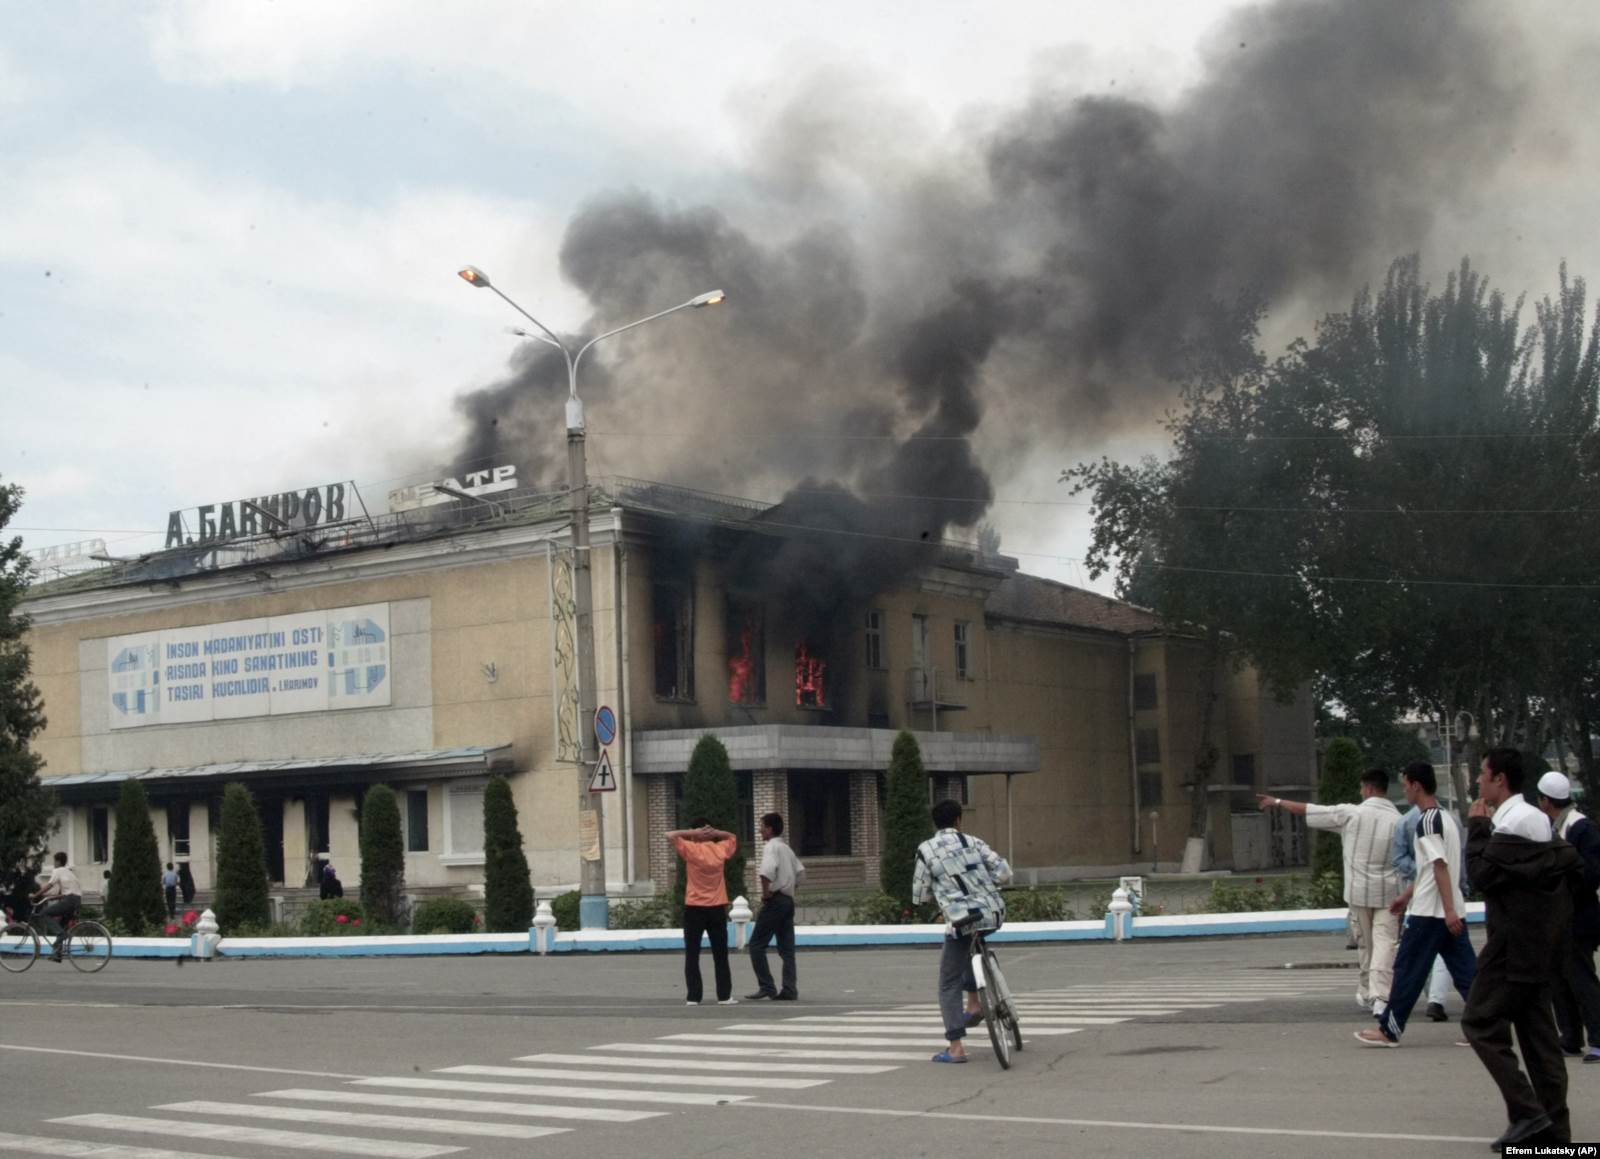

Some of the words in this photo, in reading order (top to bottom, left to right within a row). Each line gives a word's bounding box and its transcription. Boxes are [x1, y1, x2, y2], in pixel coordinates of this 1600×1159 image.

[166, 641, 199, 660] INSON
[204, 631, 286, 655] MADANIYATINI
[212, 658, 239, 677] KINO
[244, 650, 318, 673] SANATINING
[167, 684, 204, 702] TASIRI
